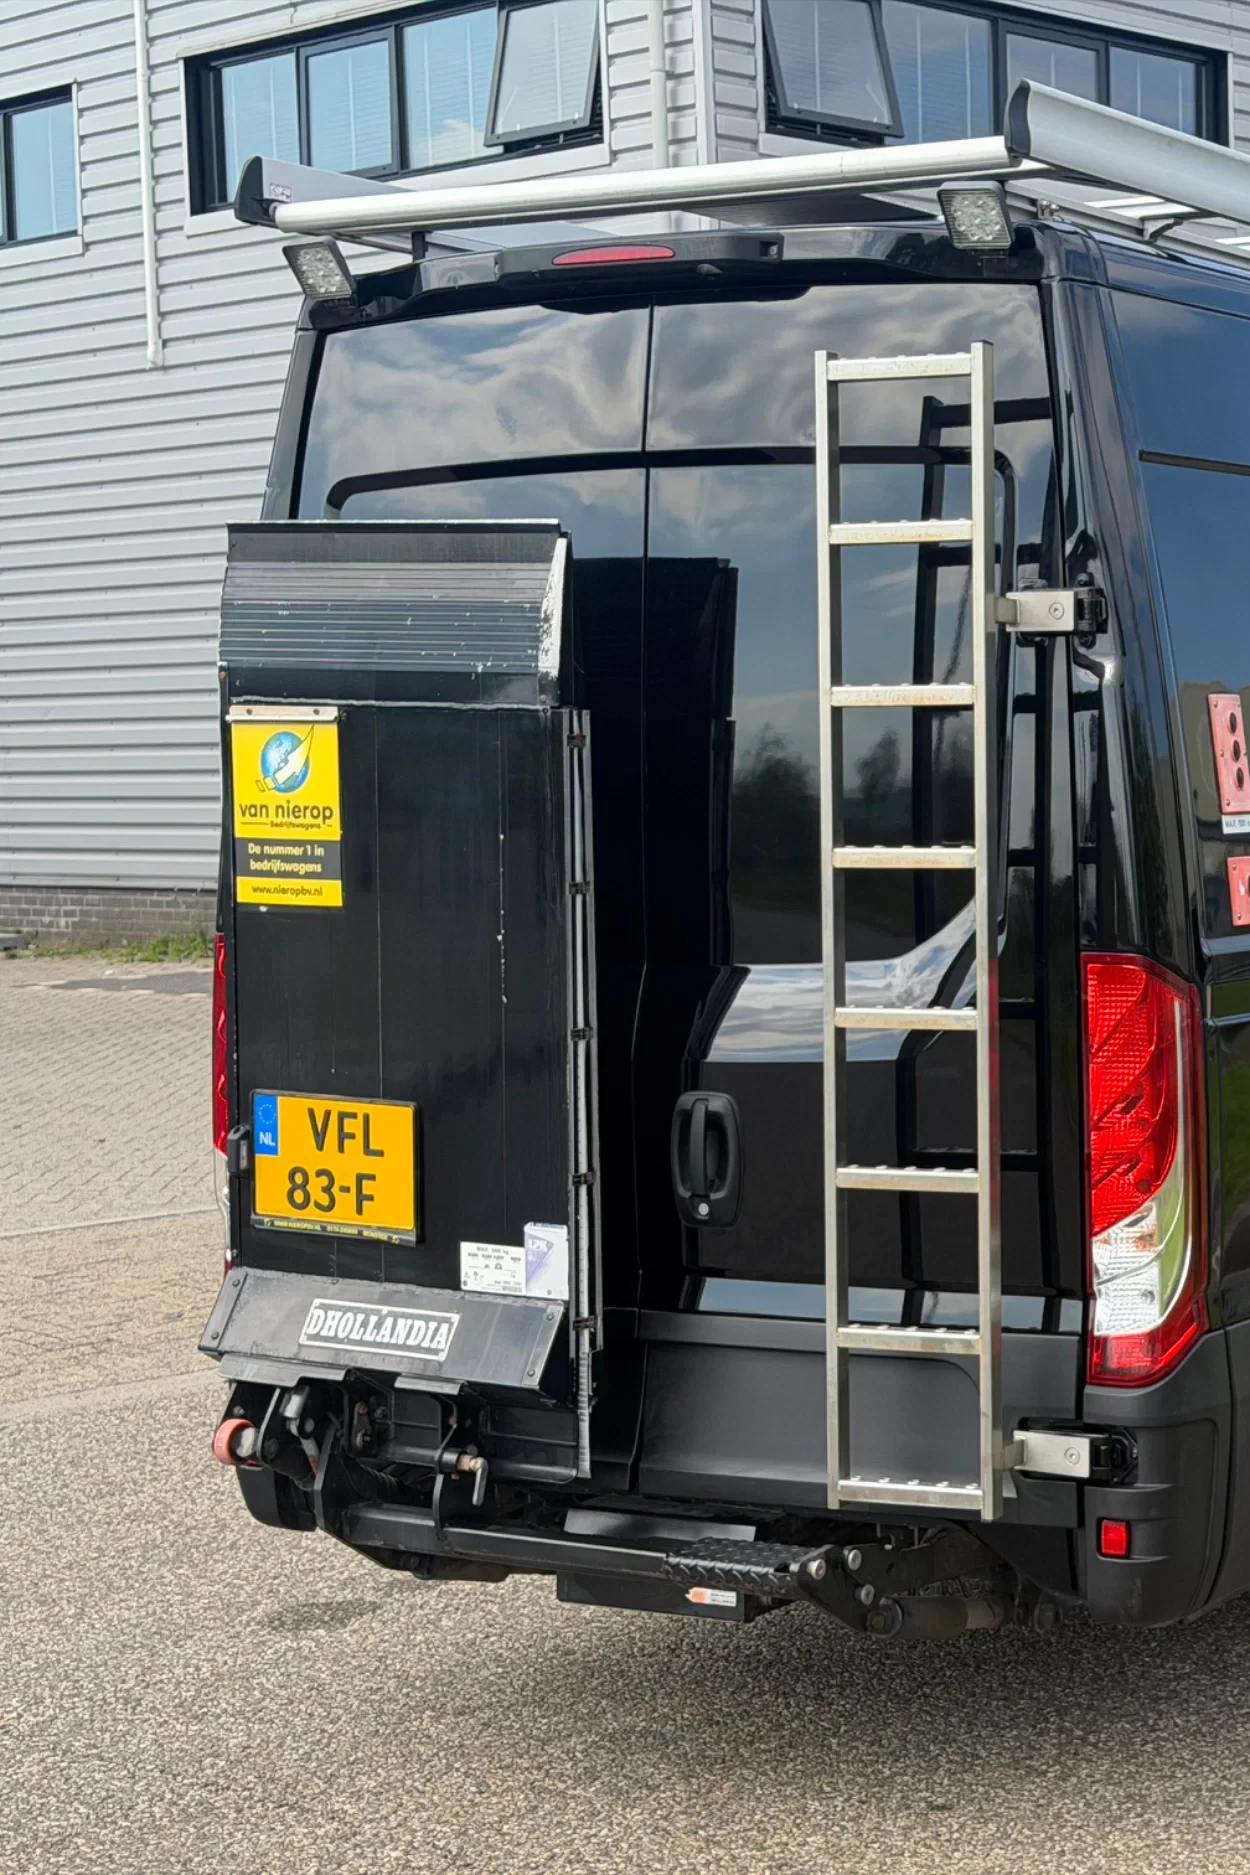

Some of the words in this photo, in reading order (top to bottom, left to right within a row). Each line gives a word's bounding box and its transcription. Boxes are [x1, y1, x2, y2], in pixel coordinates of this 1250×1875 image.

[239, 803, 269, 819] van
[275, 799, 334, 823] nierop
[248, 843, 261, 855] De
[263, 845, 304, 856] nummer
[306, 845, 312, 856] 1
[314, 844, 325, 857] in
[250, 858, 322, 874] bedrijfswagens
[251, 882, 323, 898] www.nieropbv.nl
[259, 1131, 276, 1147] NL
[307, 1107, 384, 1158] VFL
[286, 1166, 377, 1216] 83-F
[306, 1308, 450, 1350] DHOLLANDIA
